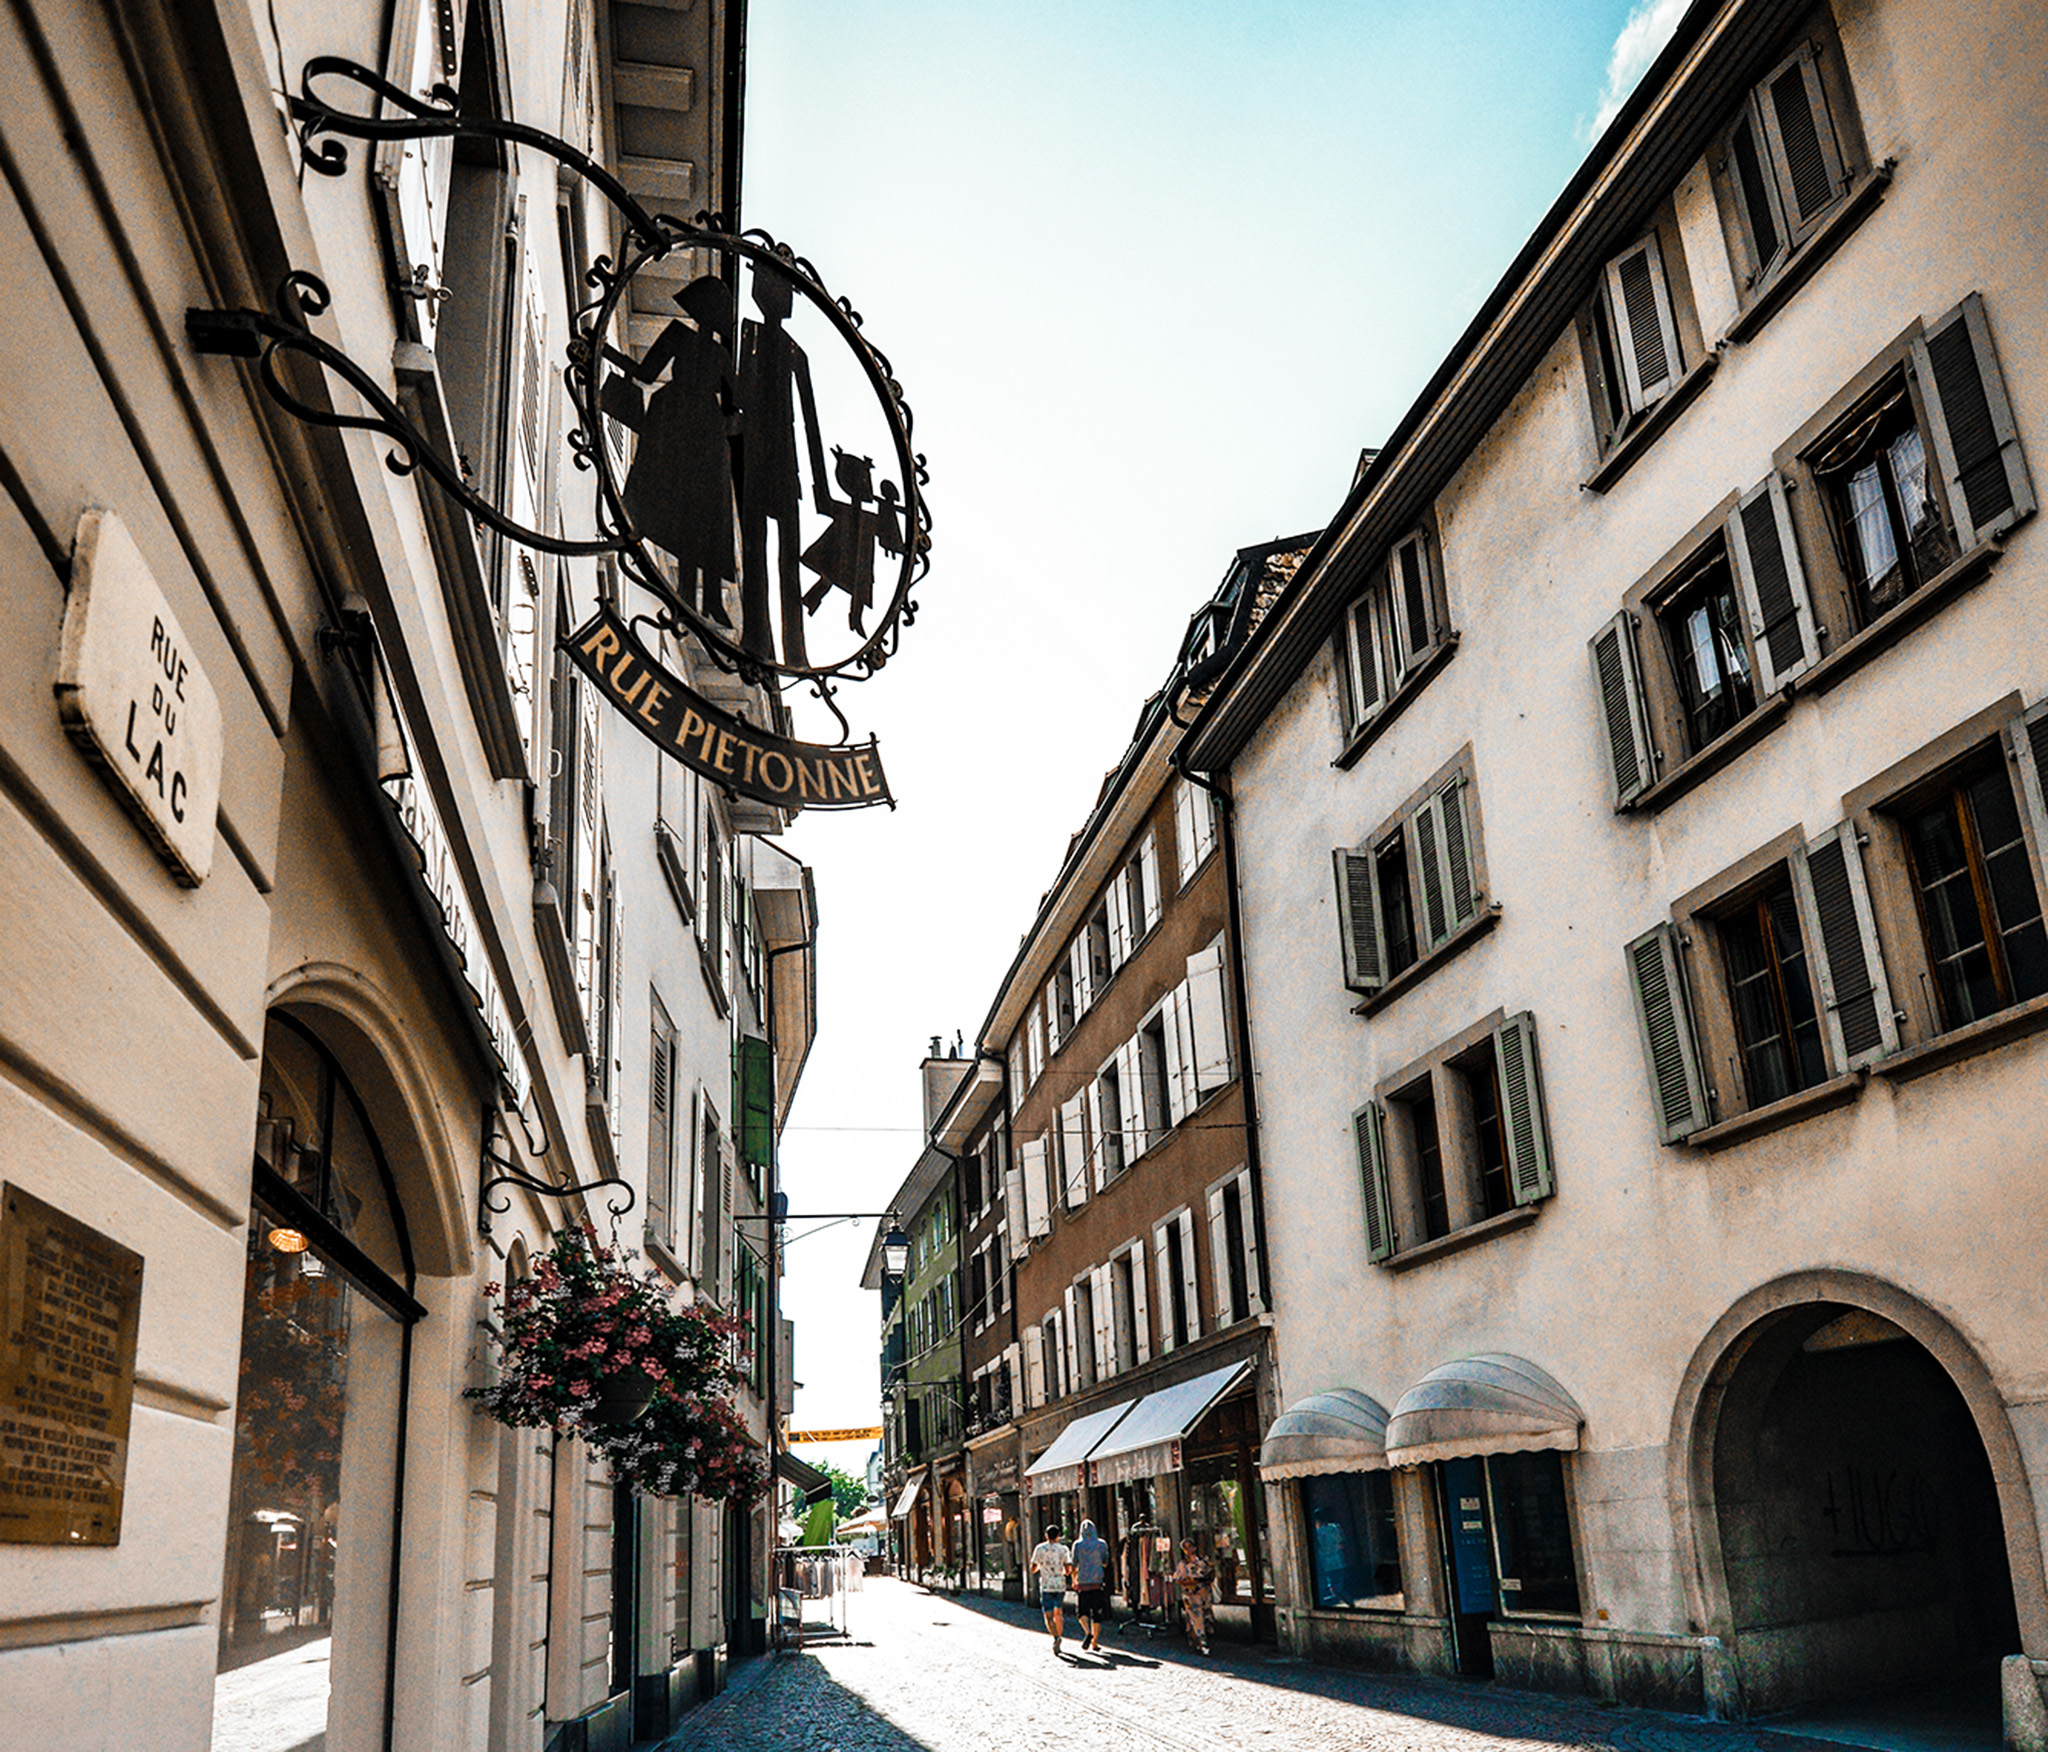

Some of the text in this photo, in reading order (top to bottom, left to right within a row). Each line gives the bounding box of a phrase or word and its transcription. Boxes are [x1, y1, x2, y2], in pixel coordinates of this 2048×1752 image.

[152, 615, 188, 703] RUE
[152, 683, 176, 736] DU
[580, 623, 882, 799] RUE PIETONNE
[125, 699, 187, 824] LAC
